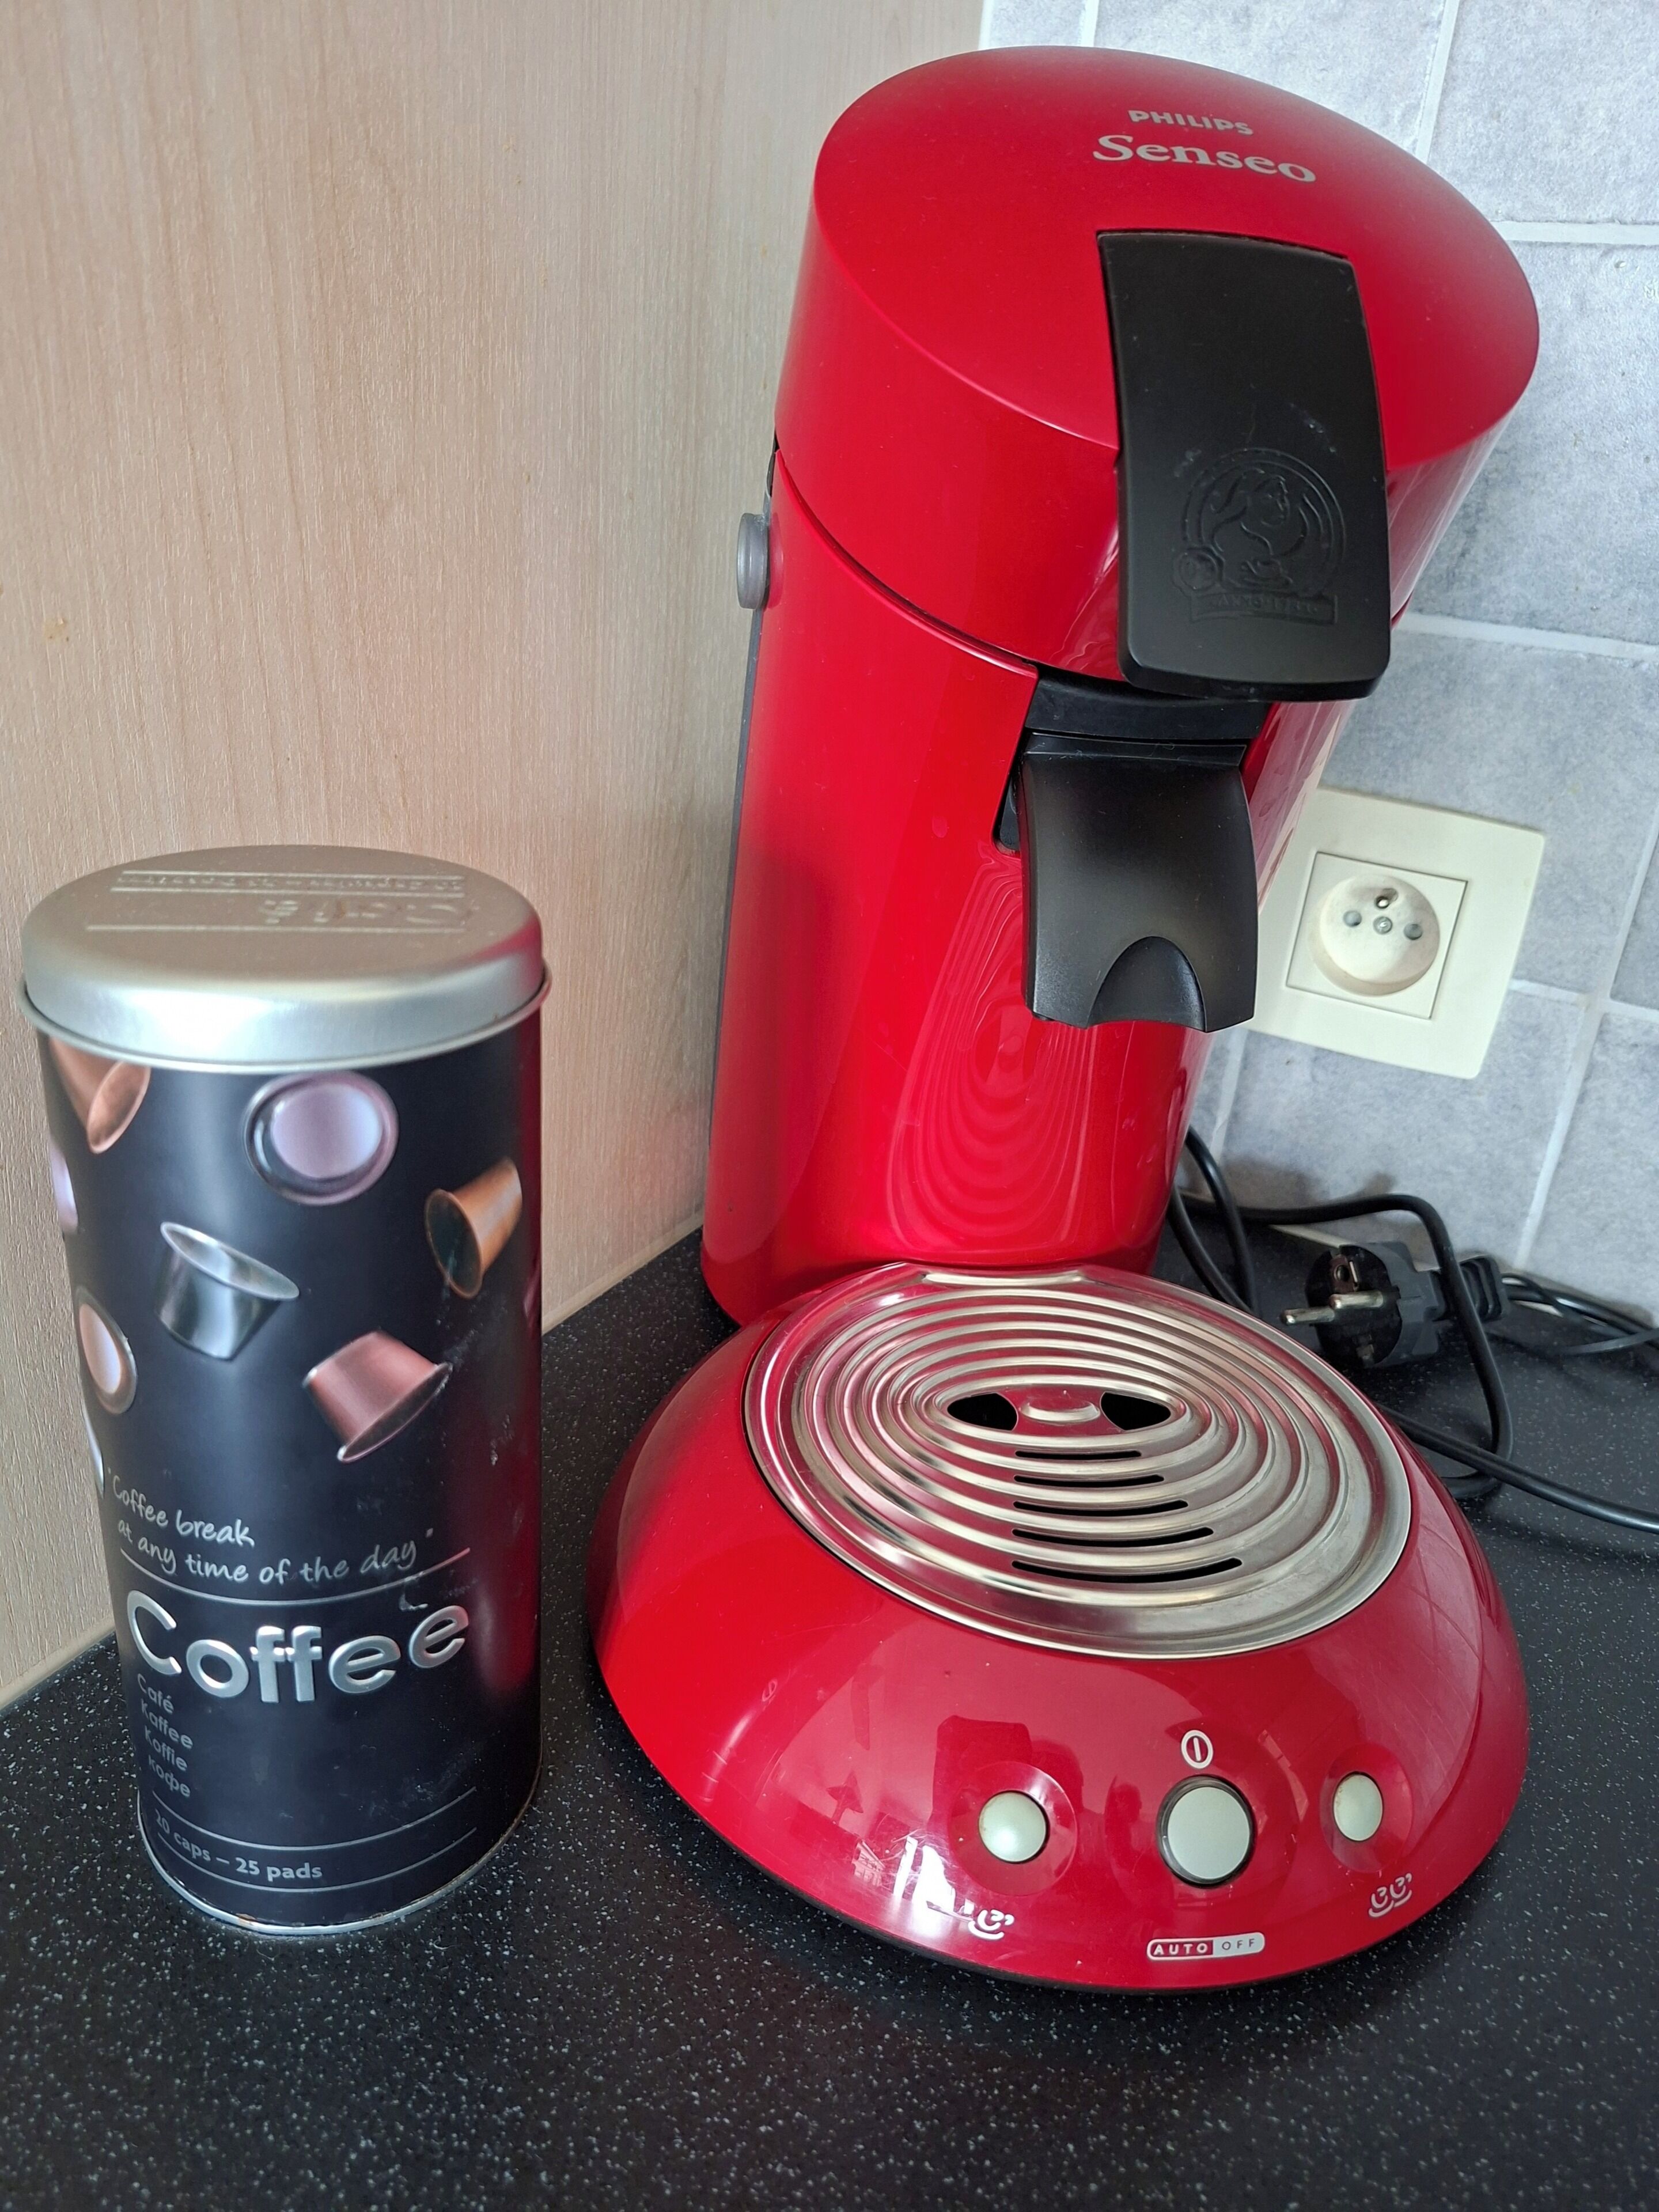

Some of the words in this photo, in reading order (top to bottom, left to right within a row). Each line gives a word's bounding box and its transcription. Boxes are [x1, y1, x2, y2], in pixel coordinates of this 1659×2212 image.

[1127, 109, 1253, 135] PHILIPS
[1092, 134, 1317, 182] Senseo
[118, 1519, 133, 1544] at
[138, 1536, 177, 1575] any
[184, 1554, 249, 1583] time
[259, 1558, 290, 1585] of
[300, 1556, 350, 1585] the
[176, 1509, 255, 1548] break
[126, 1589, 469, 1703] Coffee
[137, 1672, 174, 1714] Café
[141, 1698, 194, 1749] Kaffee
[145, 1725, 188, 1772] Koffie
[173, 1832, 211, 1862] caps
[235, 1856, 260, 1875] 25
[267, 1862, 323, 1881] pads
[1153, 1943, 1207, 1956] AUTO
[1221, 1937, 1255, 1950] OFF
